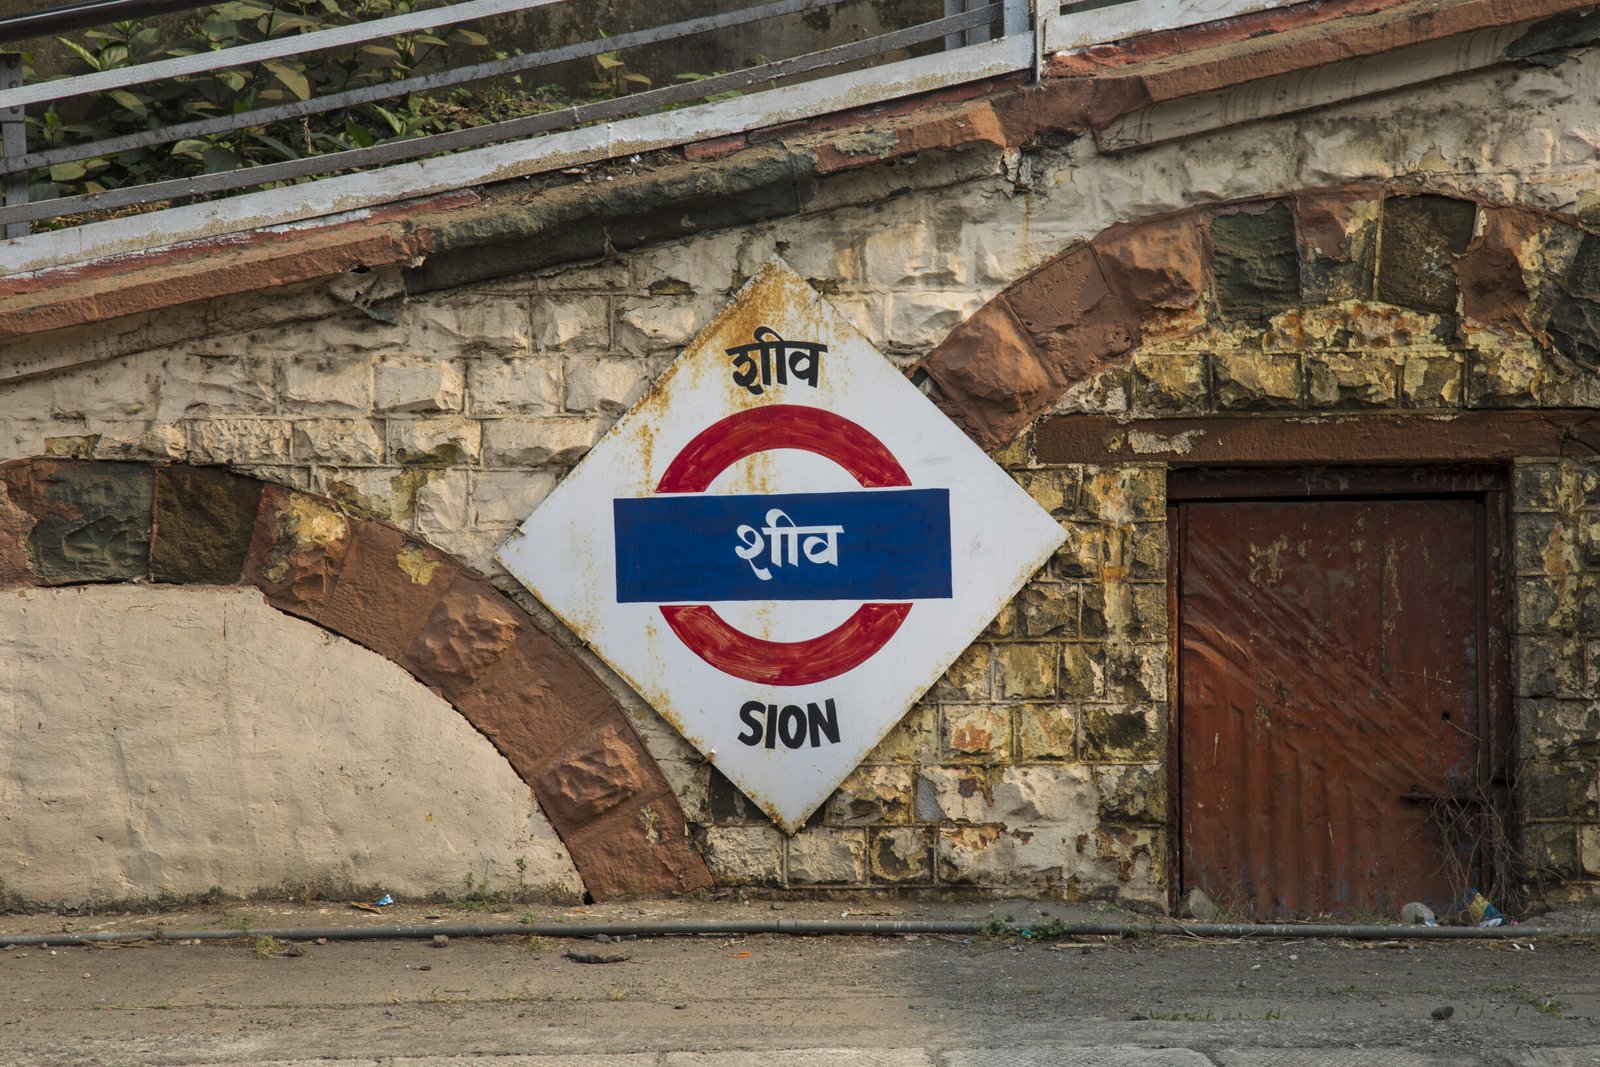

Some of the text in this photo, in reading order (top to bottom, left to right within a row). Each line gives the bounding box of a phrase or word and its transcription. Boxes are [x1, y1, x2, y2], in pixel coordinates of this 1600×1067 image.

[725, 326, 828, 395] शीव
[734, 508, 845, 581] शीव
[737, 697, 841, 750] SION
